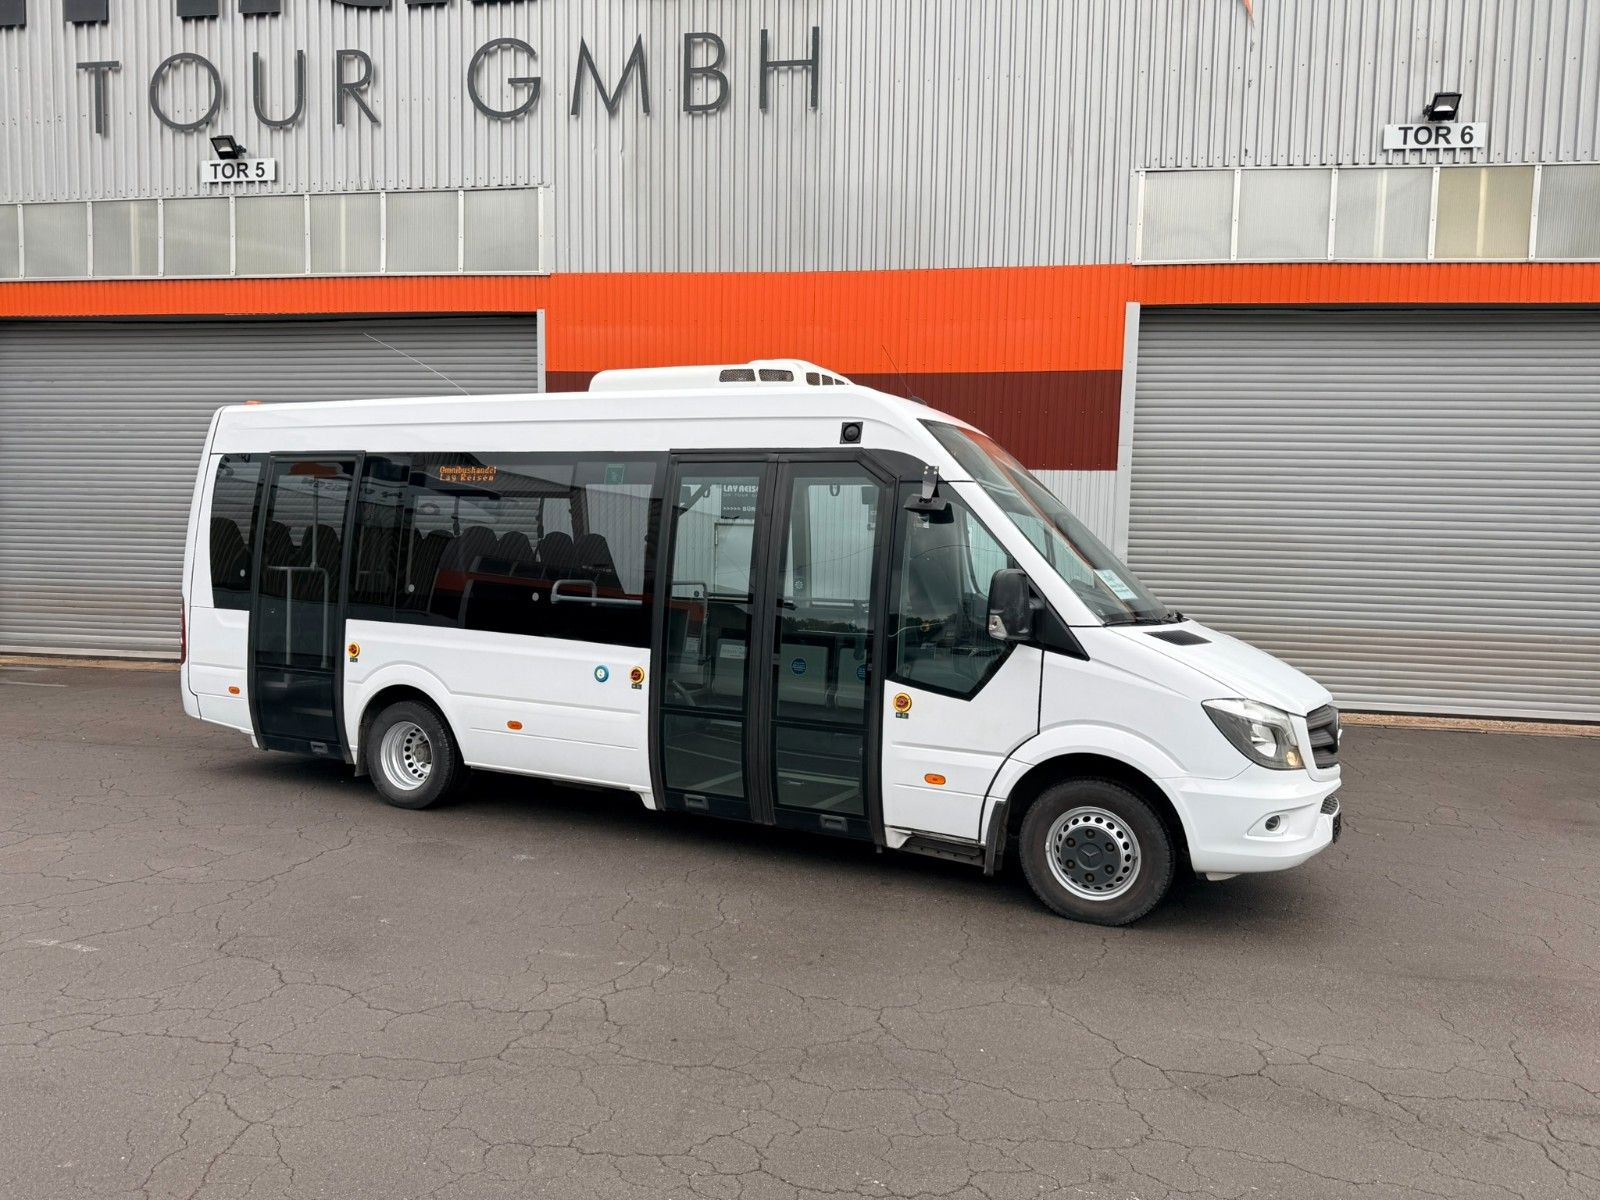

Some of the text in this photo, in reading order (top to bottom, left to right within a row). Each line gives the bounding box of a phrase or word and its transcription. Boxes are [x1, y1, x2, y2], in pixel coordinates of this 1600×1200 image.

[76, 26, 820, 133] TOUR GMBH
[1398, 125, 1474, 145] TOR 6
[210, 161, 265, 179] TOR 5
